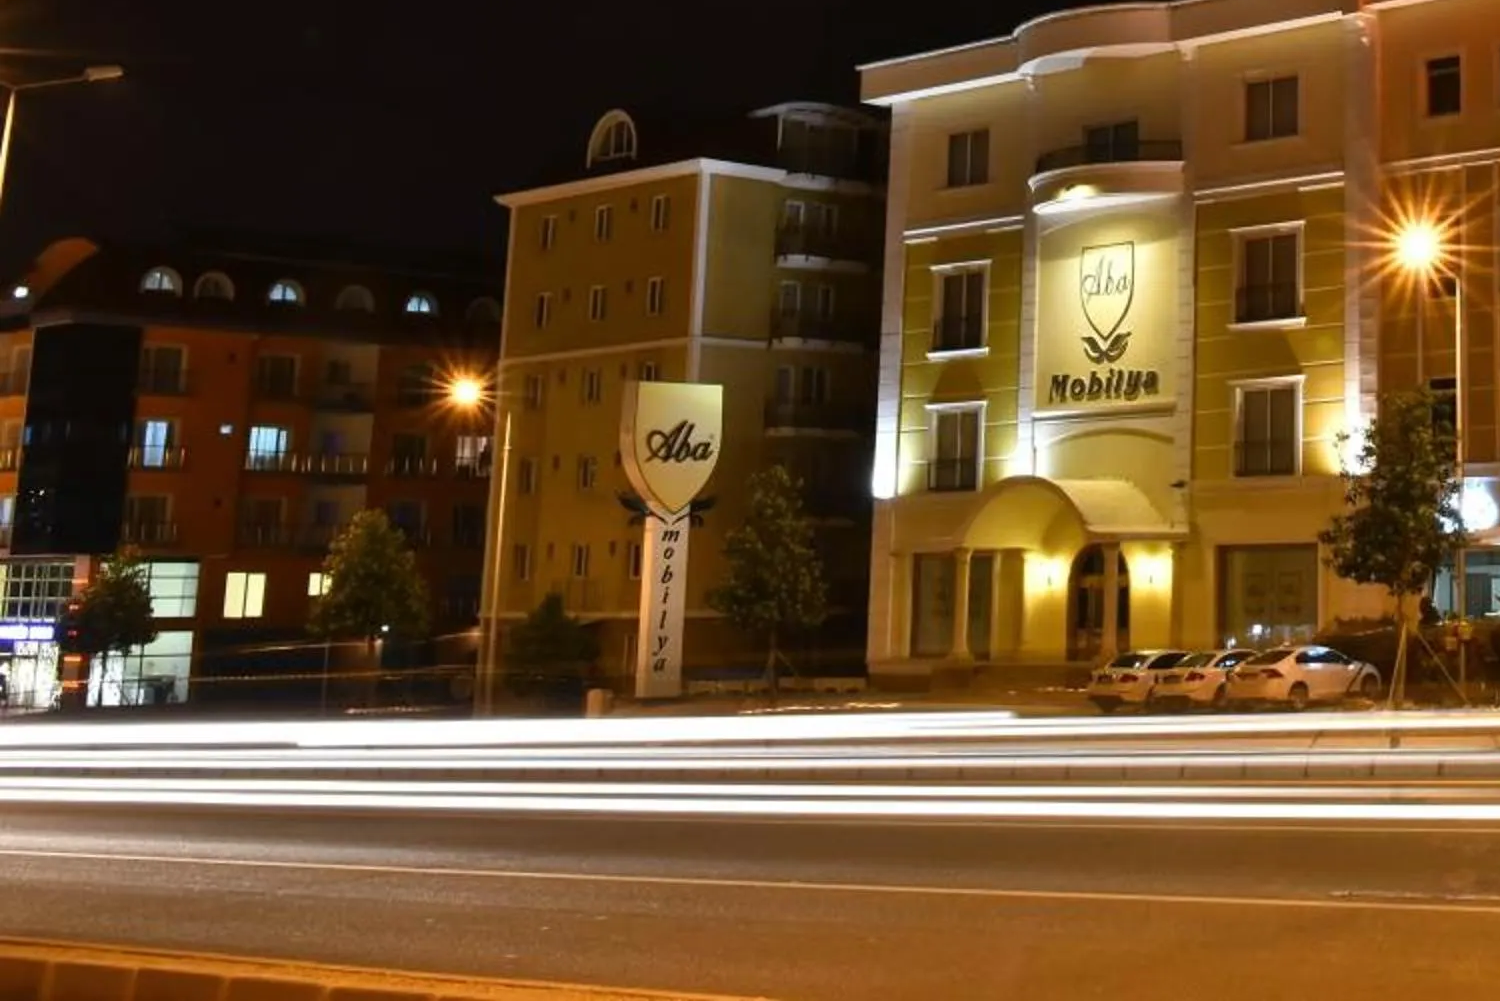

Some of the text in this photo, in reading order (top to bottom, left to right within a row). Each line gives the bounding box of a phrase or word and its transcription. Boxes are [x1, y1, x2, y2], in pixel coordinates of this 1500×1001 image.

[1049, 369, 1159, 403] Mobilya
[645, 419, 713, 463] Aba
[652, 530, 680, 672] mobilya
